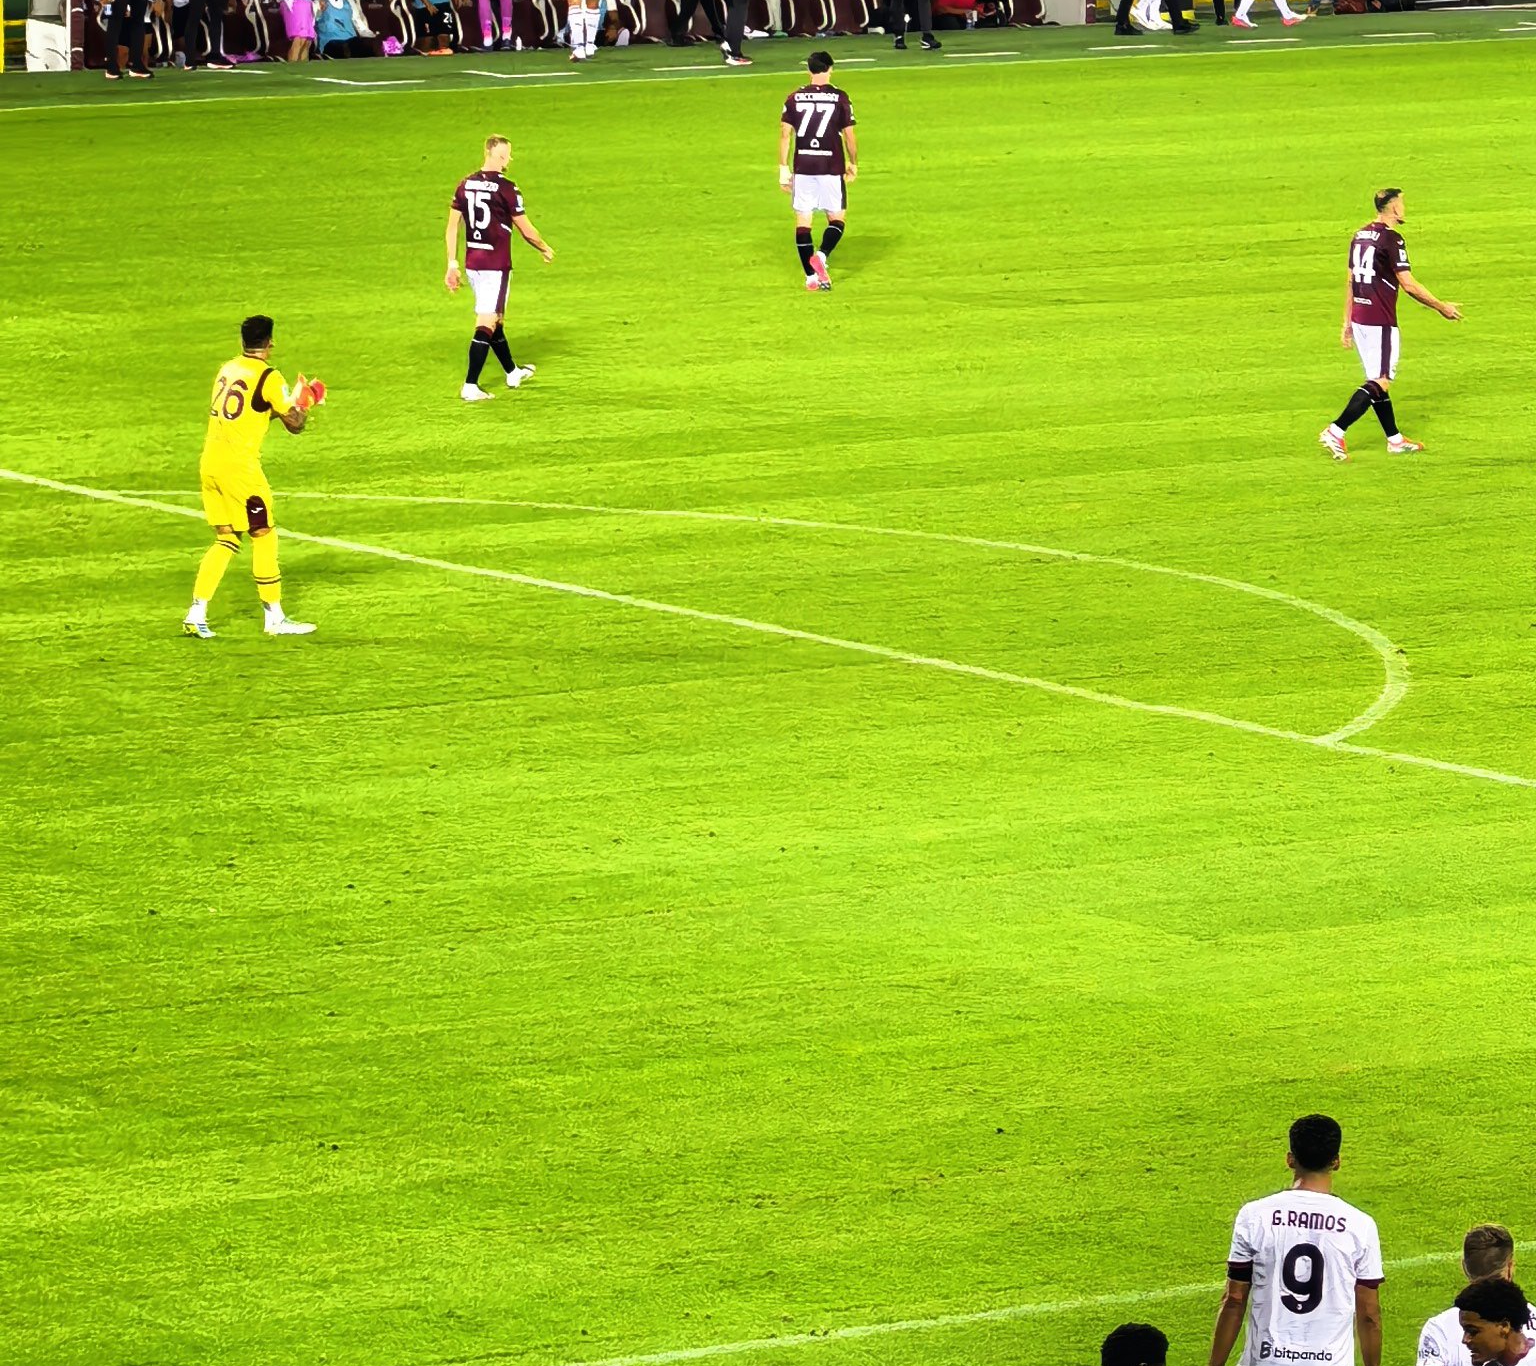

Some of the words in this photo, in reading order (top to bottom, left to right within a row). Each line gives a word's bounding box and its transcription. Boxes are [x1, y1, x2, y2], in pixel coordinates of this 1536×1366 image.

[795, 102, 836, 138] 77
[464, 190, 491, 230] 15
[1272, 1209, 1347, 1233] G.RAMOS
[1280, 1242, 1325, 1315] 9
[1274, 1345, 1333, 1363] bitpanda
